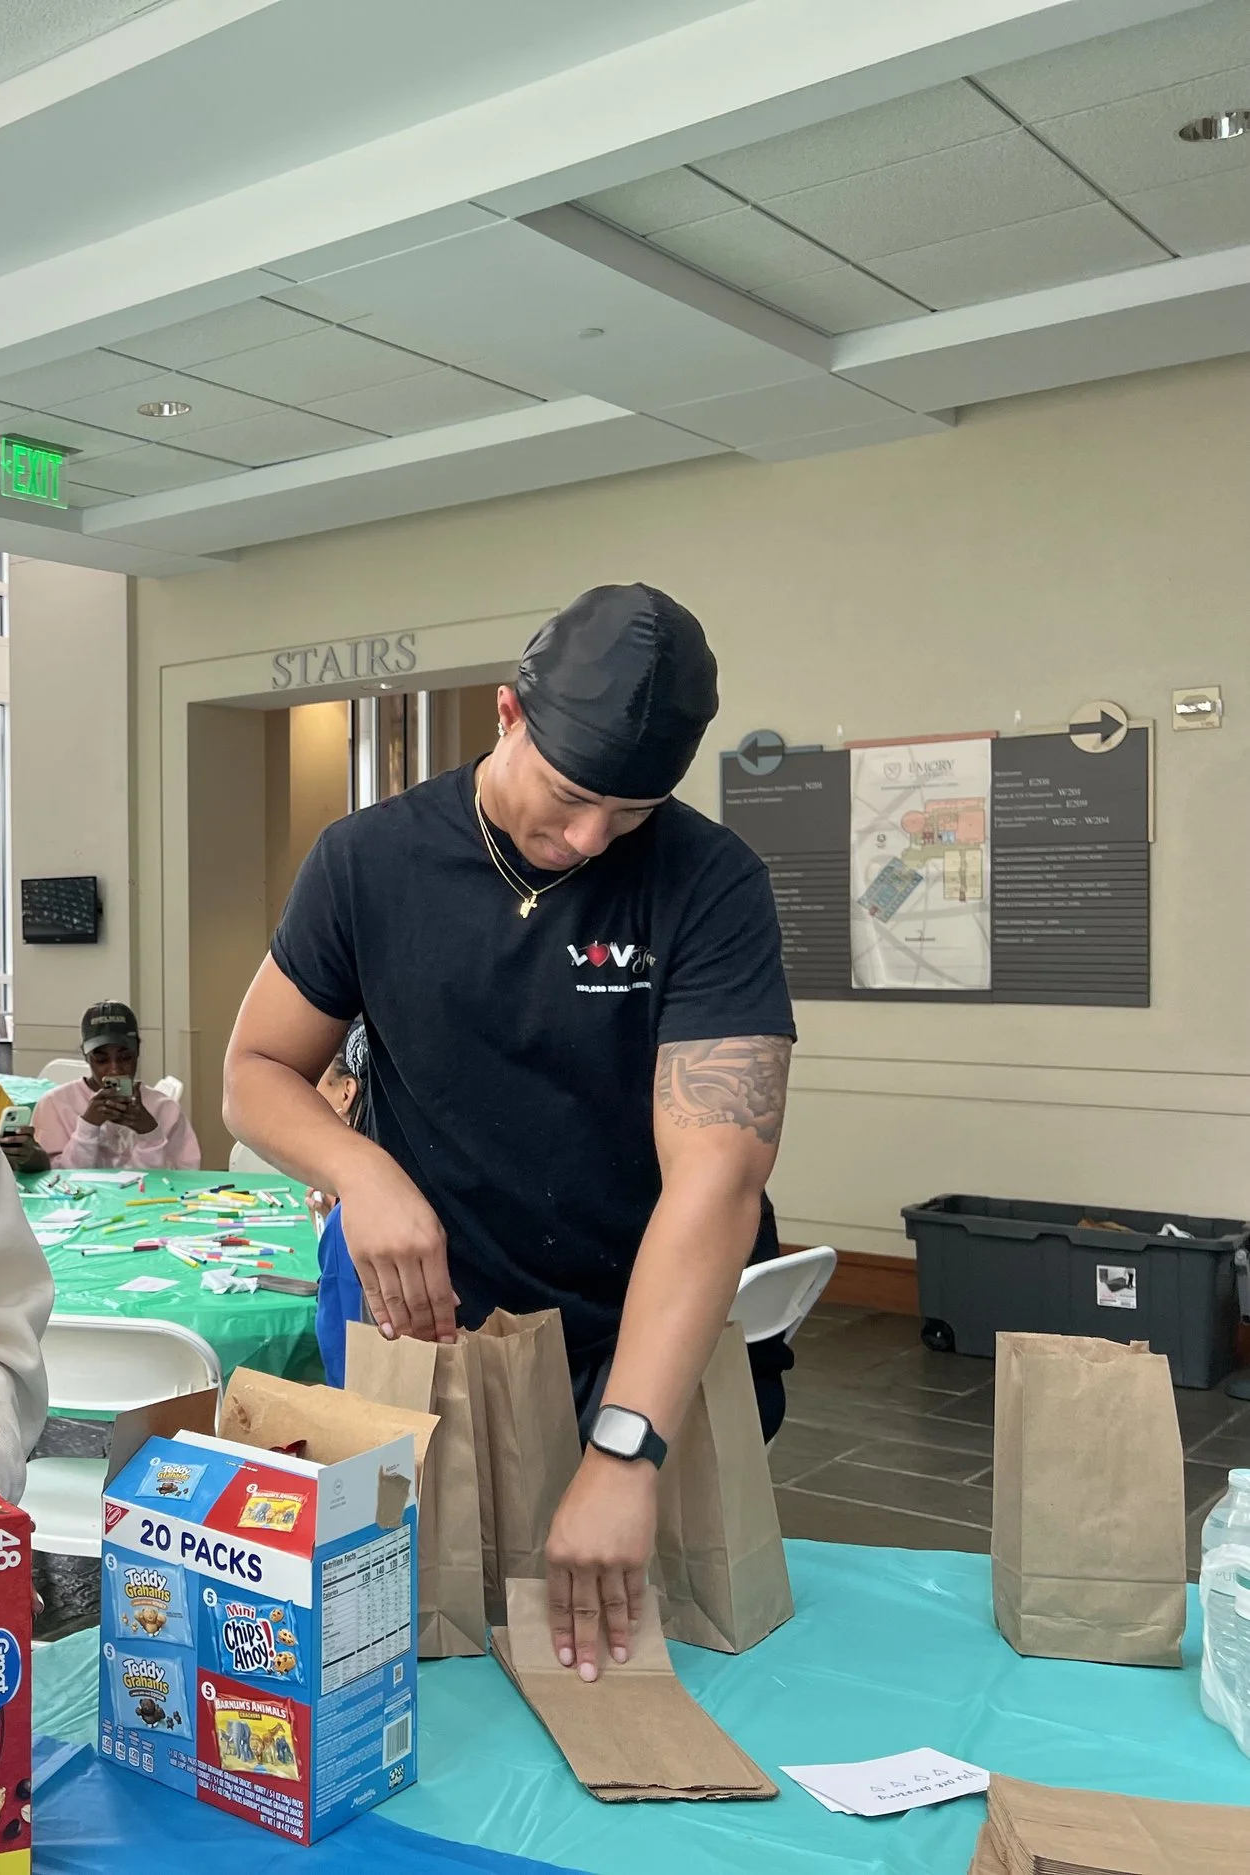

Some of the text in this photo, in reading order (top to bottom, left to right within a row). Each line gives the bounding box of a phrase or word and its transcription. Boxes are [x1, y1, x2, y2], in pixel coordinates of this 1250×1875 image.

[13, 445, 62, 500] EXIT
[272, 632, 416, 689] STAIRS
[161, 1465, 191, 1475] Teddy
[141, 1519, 262, 1583] 20 PACKS
[344, 1552, 356, 1563] Facts
[125, 1568, 167, 1590] Teddy
[376, 1565, 384, 1576] 140
[125, 1584, 170, 1602] Grahams
[226, 1604, 255, 1619] Mini
[224, 1620, 263, 1651] Chips
[123, 1659, 165, 1682] Teddy
[123, 1675, 169, 1694] Grahams
[216, 1700, 287, 1718] BARNUM'S ANIMALS
[877, 1785, 932, 1801] amazing
[934, 1779, 954, 1789] are
